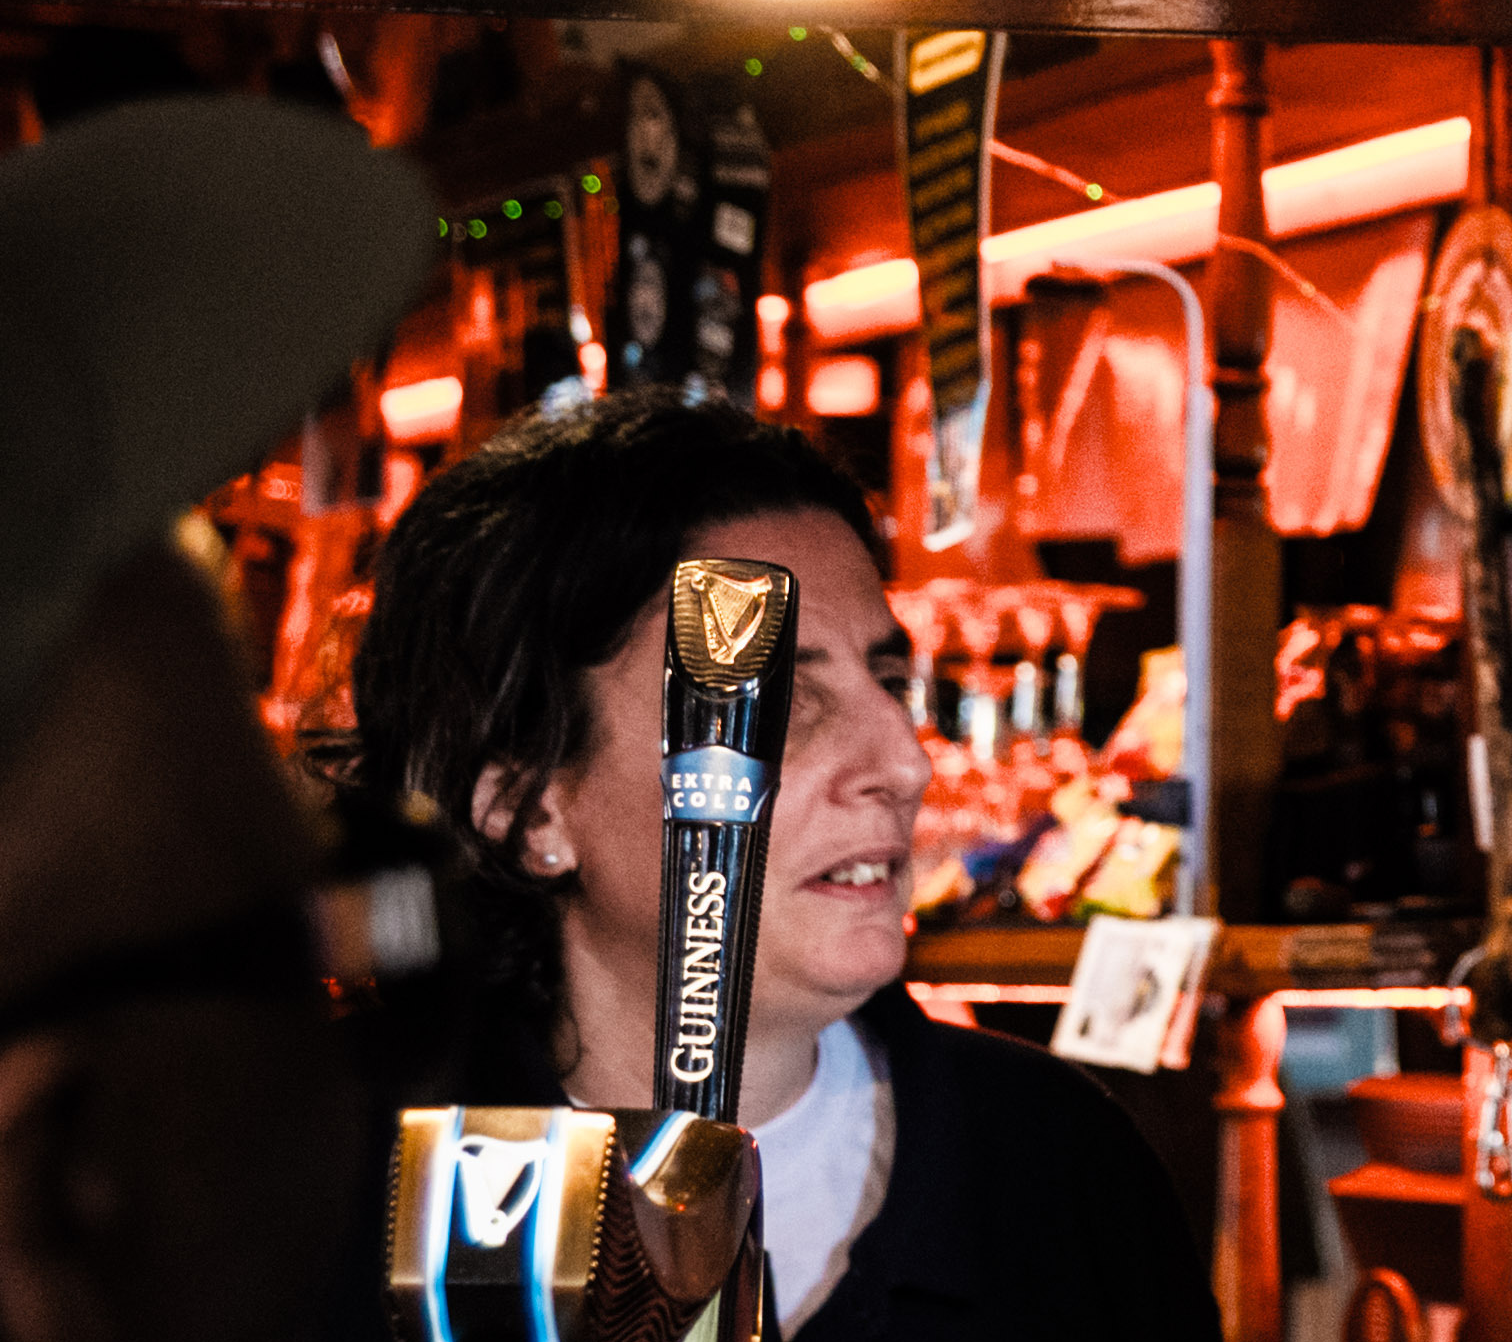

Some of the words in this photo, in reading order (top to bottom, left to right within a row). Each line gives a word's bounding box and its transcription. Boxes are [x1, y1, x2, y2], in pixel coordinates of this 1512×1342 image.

[671, 772, 753, 793] EXTRA
[672, 791, 751, 812] COLD
[669, 870, 727, 1084] GUINNESS
